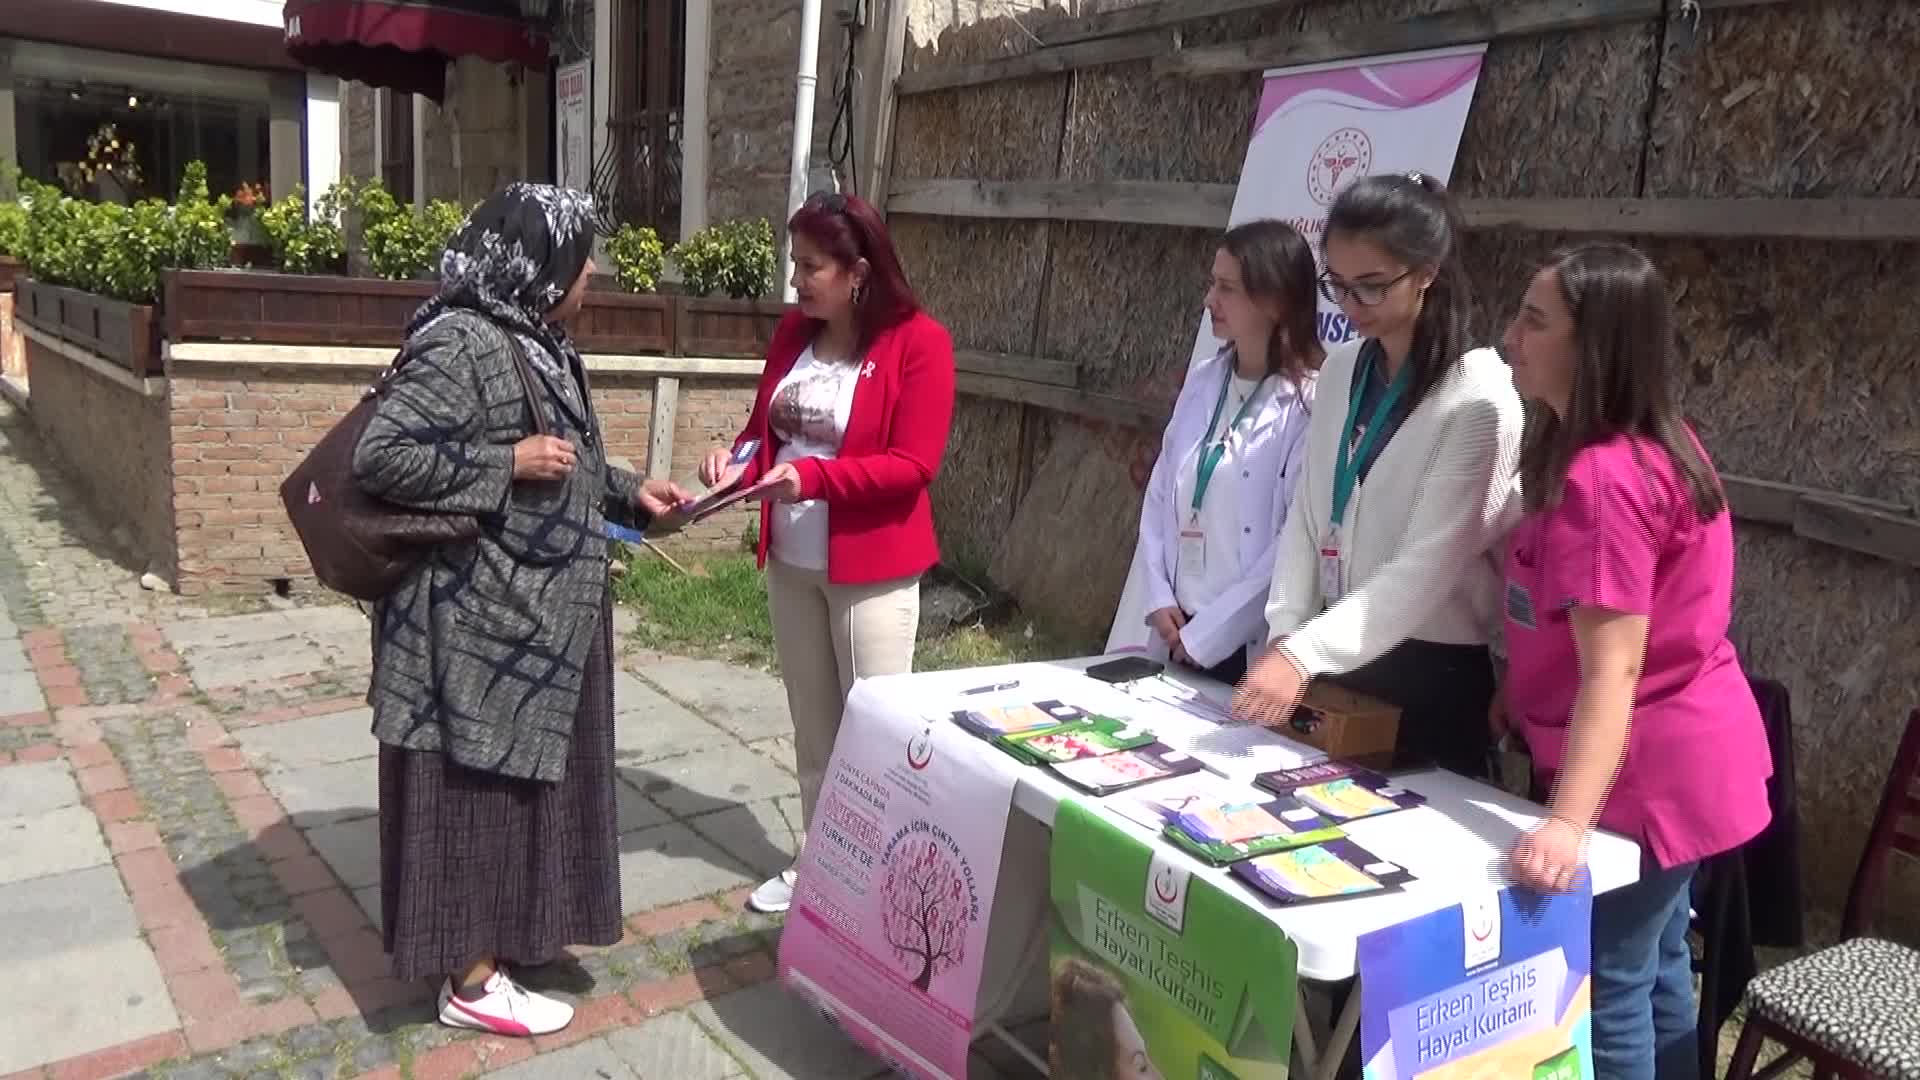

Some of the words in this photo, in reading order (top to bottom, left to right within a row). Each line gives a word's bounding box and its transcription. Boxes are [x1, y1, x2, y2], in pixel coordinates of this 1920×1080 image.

[1095, 897, 1150, 953] Erken
[1095, 923, 1145, 975] Hayat
[1416, 994, 1473, 1033] Erken
[1480, 967, 1538, 1004] Teşhis
[1417, 1027, 1468, 1064] Hayat
[1474, 999, 1538, 1039] Kurtarır.
